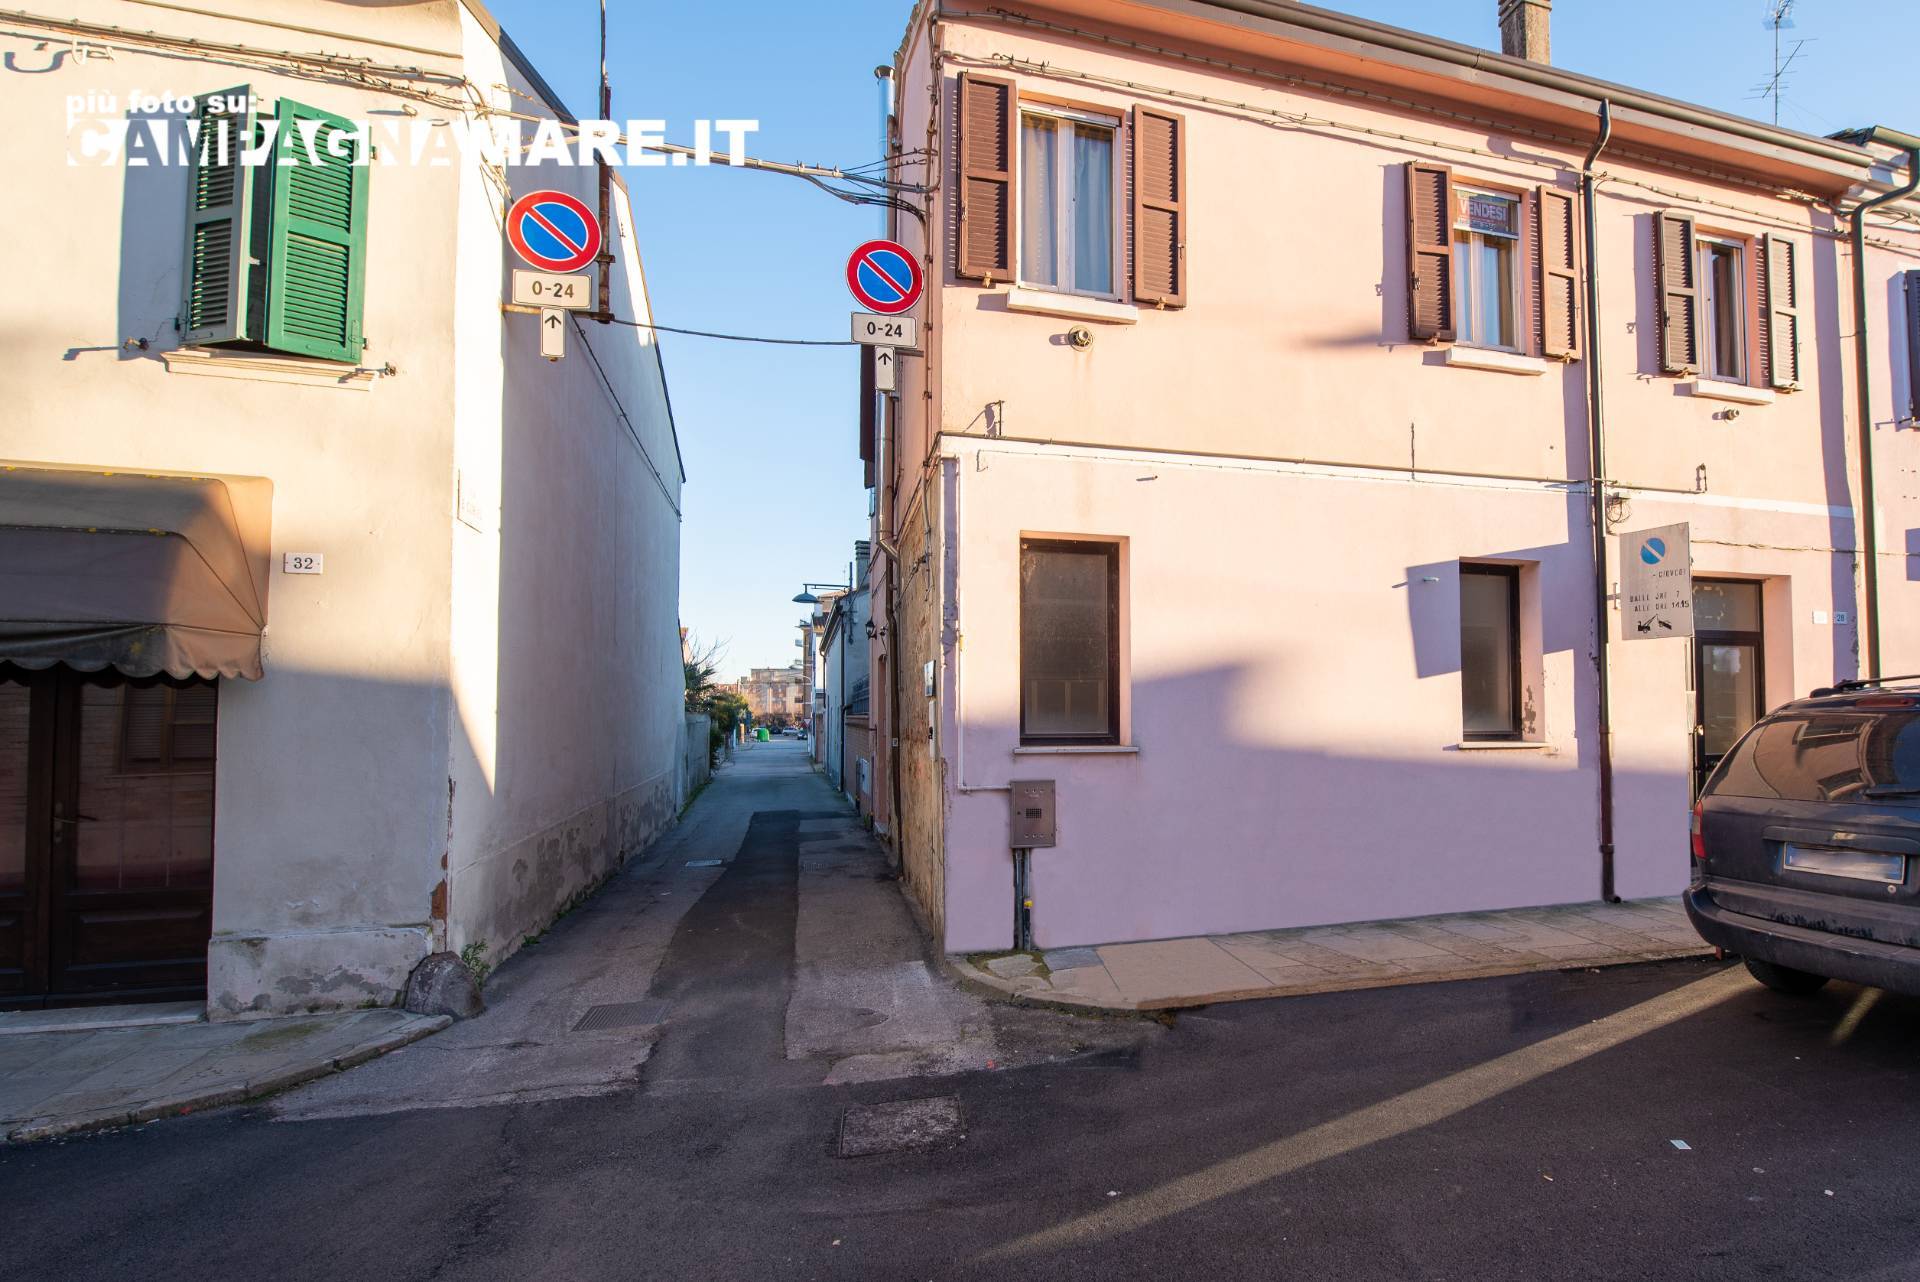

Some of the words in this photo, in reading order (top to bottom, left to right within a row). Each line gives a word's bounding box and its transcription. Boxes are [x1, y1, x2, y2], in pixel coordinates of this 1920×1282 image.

[1460, 200, 1507, 222] VENDESI
[532, 281, 574, 298] 0-24
[867, 322, 902, 337] 0-24
[294, 557, 313, 570] 32
